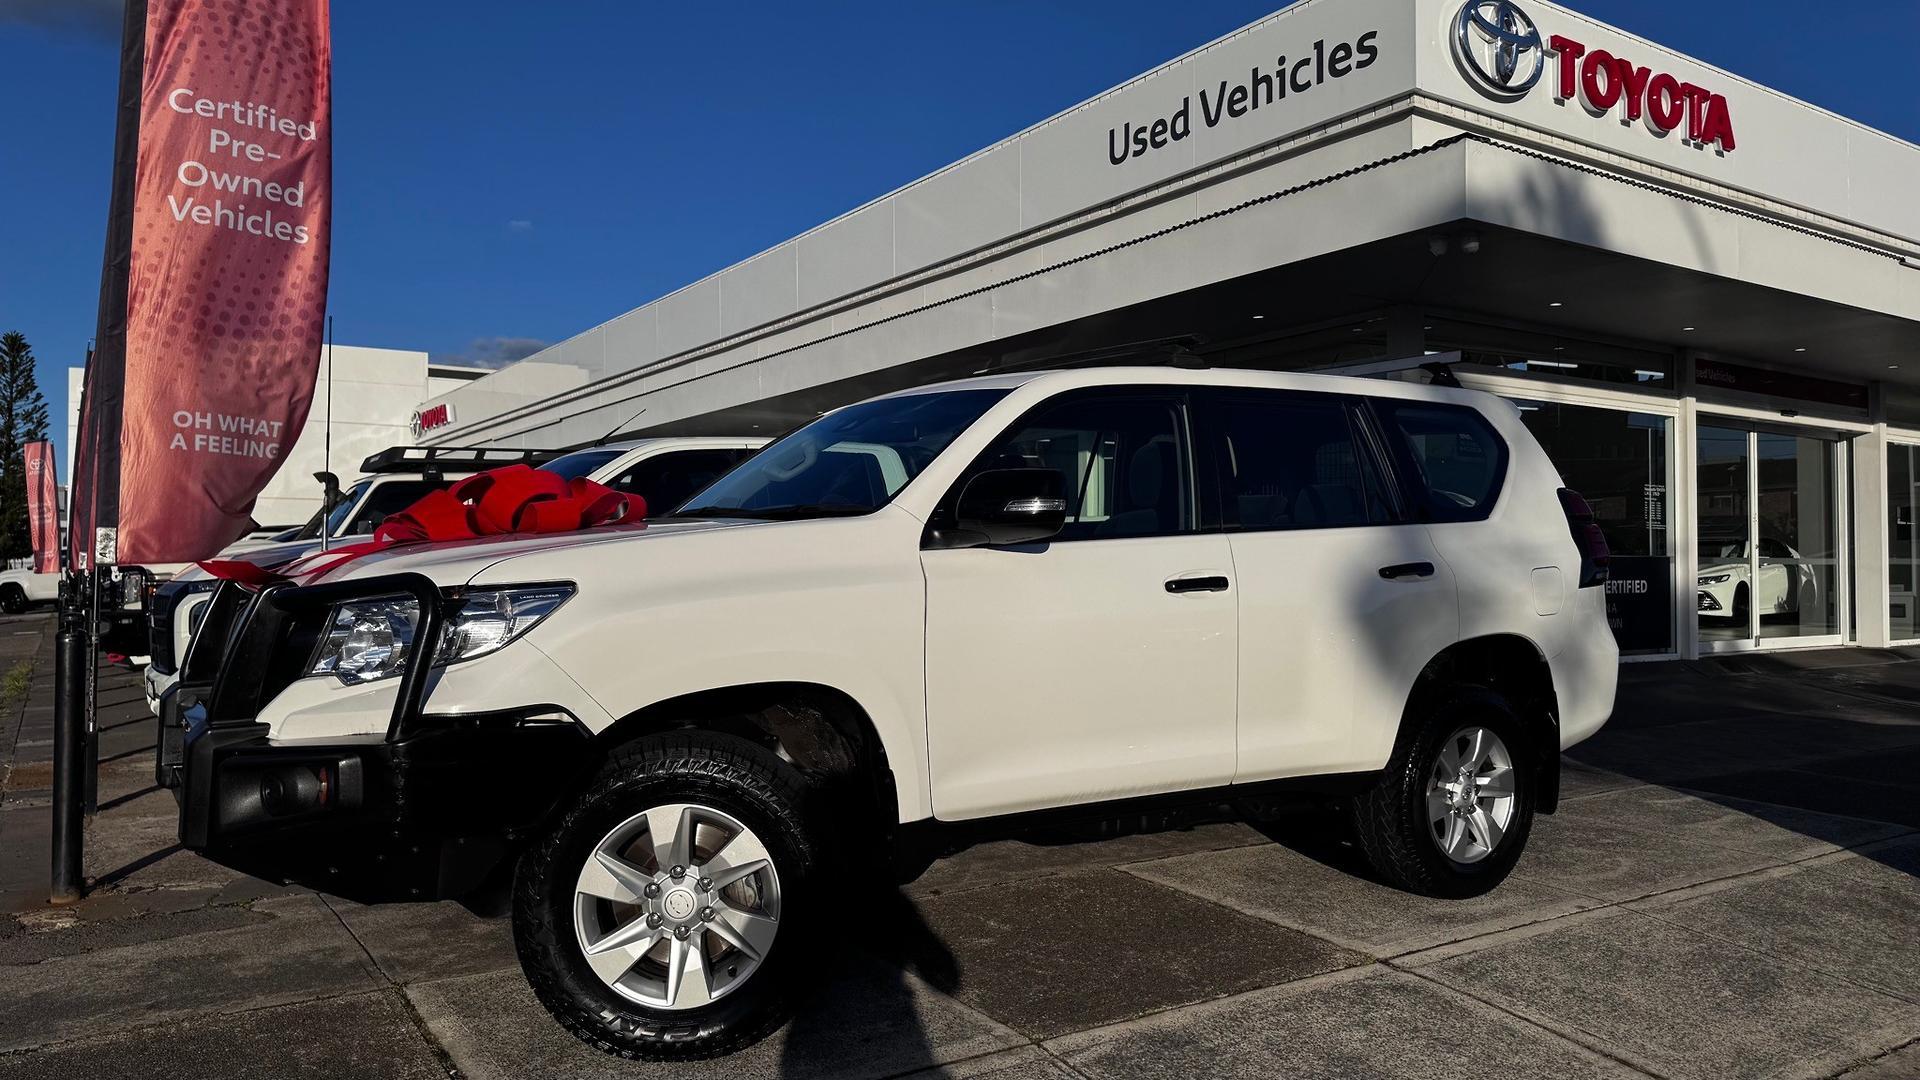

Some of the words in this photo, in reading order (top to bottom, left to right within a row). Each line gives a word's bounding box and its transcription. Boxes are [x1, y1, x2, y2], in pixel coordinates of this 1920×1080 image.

[168, 88, 317, 141] Certified
[1108, 96, 1190, 166] Used
[1199, 30, 1378, 128] Vehicles
[1550, 34, 1736, 153] TOYOTA
[209, 128, 281, 162] Pre-
[177, 160, 304, 208] Owned
[167, 195, 309, 244] Vehicles
[170, 433, 188, 450] A
[194, 434, 280, 460] FEELING
[173, 411, 212, 430] OH
[218, 414, 283, 438] WHAT
[1605, 579, 1648, 594] ERTIFIED
